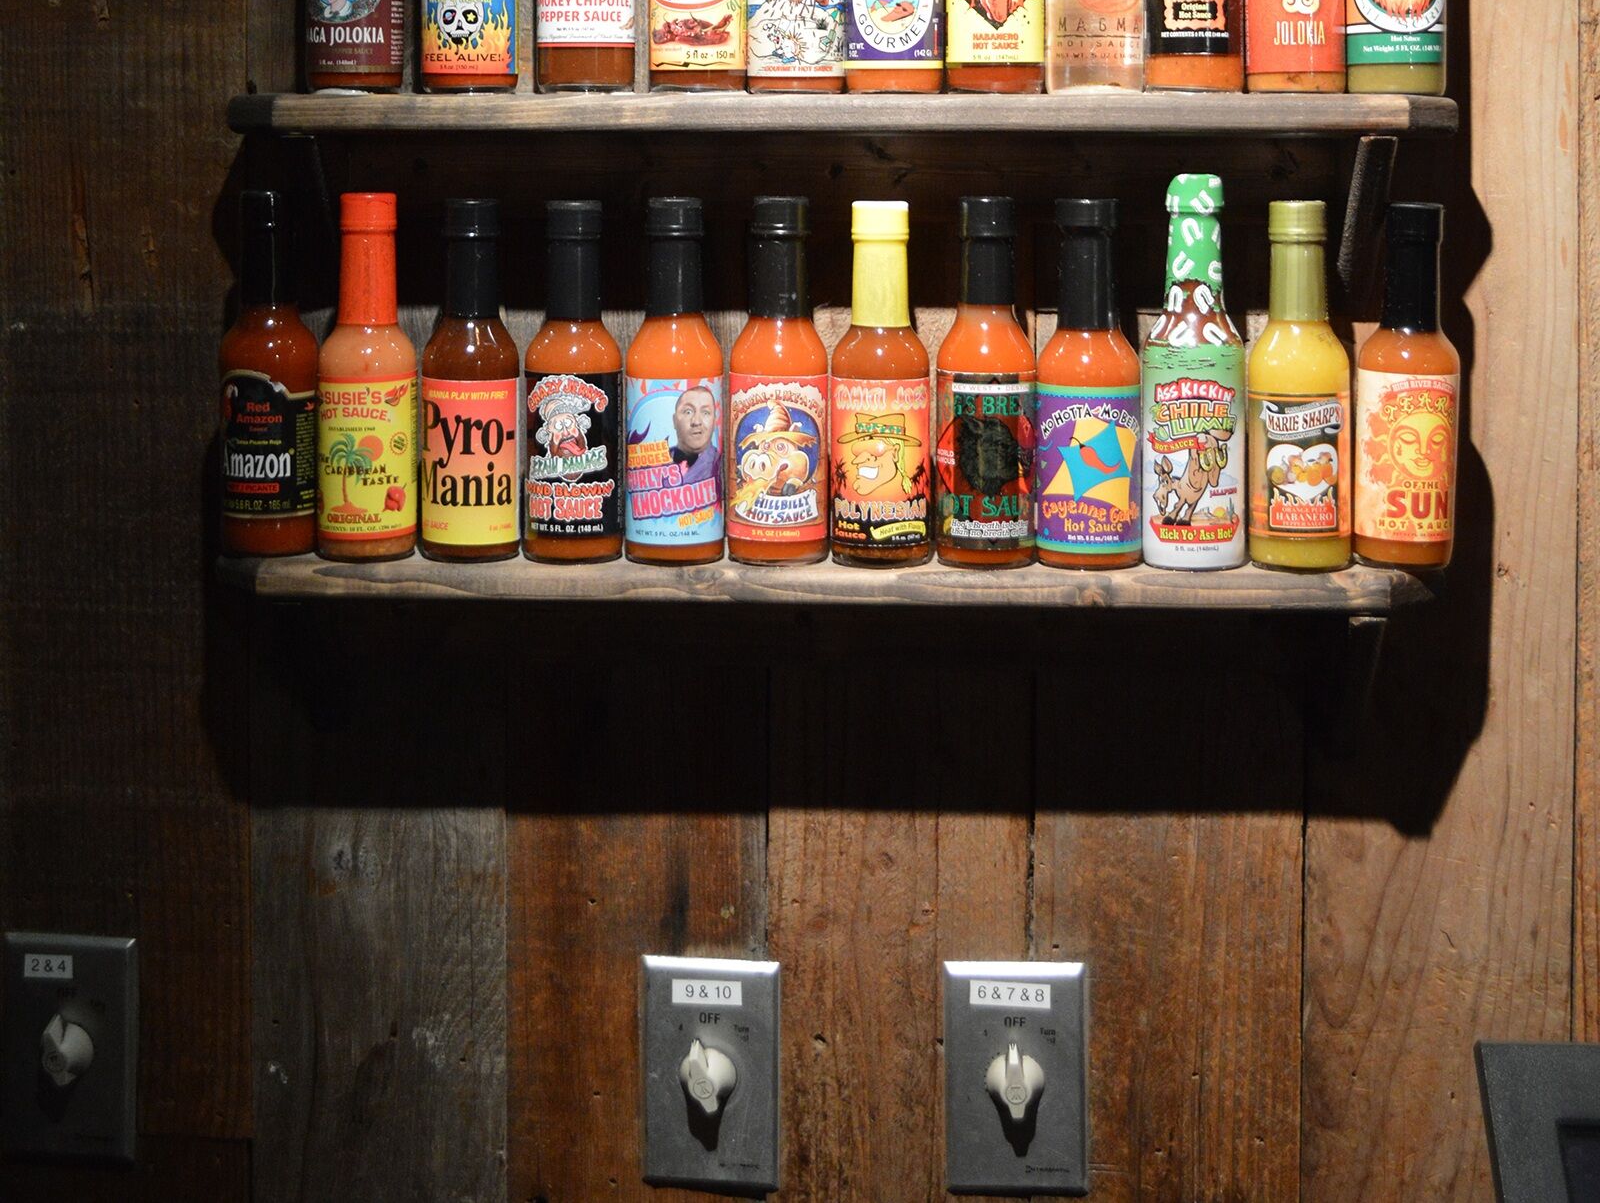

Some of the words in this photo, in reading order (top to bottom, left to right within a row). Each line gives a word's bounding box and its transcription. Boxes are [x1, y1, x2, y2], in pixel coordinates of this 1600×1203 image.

[1181, 3, 1208, 11] Original
[540, 11, 579, 22] PEPPER
[584, 11, 621, 21] SAUCE
[1179, 11, 1191, 19] Hot
[858, 13, 926, 49] GOURMET
[1059, 17, 1140, 33] MAGMA
[329, 27, 384, 45] JOLOKIA
[973, 33, 1019, 41] HABANERO
[1274, 21, 1325, 45] JOLOKIA
[973, 42, 990, 50] HOT
[325, 388, 382, 406] SUSIE'S
[451, 391, 469, 400] PLAY
[528, 378, 561, 410] CRAZY
[564, 378, 608, 411] JERRY'S
[1156, 384, 1178, 401] ASS
[1181, 380, 1234, 402] KICKIN'
[246, 402, 270, 412] Red
[320, 408, 338, 421] HOT
[342, 407, 387, 421] SAUCE
[1157, 402, 1228, 421] CHILE
[236, 414, 283, 423] Amazon
[1268, 415, 1299, 432] MARIE
[1302, 405, 1340, 429] SHARP'S
[423, 399, 515, 468] Pyro-
[1171, 417, 1235, 436] LIME
[640, 441, 667, 454] THREE
[1170, 440, 1194, 450] SAUCE
[224, 442, 291, 479] Amazon
[628, 451, 669, 466] STOOGES
[324, 464, 386, 476] CARIBBEAN
[361, 475, 399, 486] TASTE
[423, 459, 511, 507] Mania
[627, 466, 680, 491] CURLY'S
[555, 481, 614, 497] BLOWIN'
[633, 481, 716, 516] KNOCKOUT!
[755, 494, 810, 508] HILLBILLY
[1387, 490, 1448, 519] SUN
[531, 497, 551, 518] HOT
[555, 497, 602, 520] SAUCE
[835, 498, 926, 521] POLYNESIAN
[1042, 500, 1106, 521] Cayenne
[327, 513, 381, 523] ORIGINAL
[679, 516, 693, 526] HOT
[1276, 513, 1332, 521] HABANERO
[838, 520, 860, 530] Hot
[973, 521, 1000, 529] Breath
[1064, 518, 1085, 531] Hot
[1088, 519, 1122, 533] Sauce
[1378, 520, 1407, 529] HOT
[835, 528, 866, 539] Sauce
[983, 528, 1010, 536] breath
[1159, 529, 1179, 540] Kick
[1182, 529, 1197, 541] Yo'
[1200, 529, 1215, 540] Ass
[31, 959, 40, 972] 2
[44, 959, 53, 973] &
[58, 960, 66, 973] 4
[685, 985, 695, 997] 9
[699, 985, 709, 998] &
[715, 986, 732, 999] 10
[978, 986, 987, 999] 6
[991, 988, 1002, 1000] &
[1006, 988, 1015, 1000] 7
[1020, 989, 1030, 1001] &
[1035, 989, 1045, 1002] 8
[700, 1012, 720, 1025] OFF
[1004, 1016, 1026, 1028] OFF
